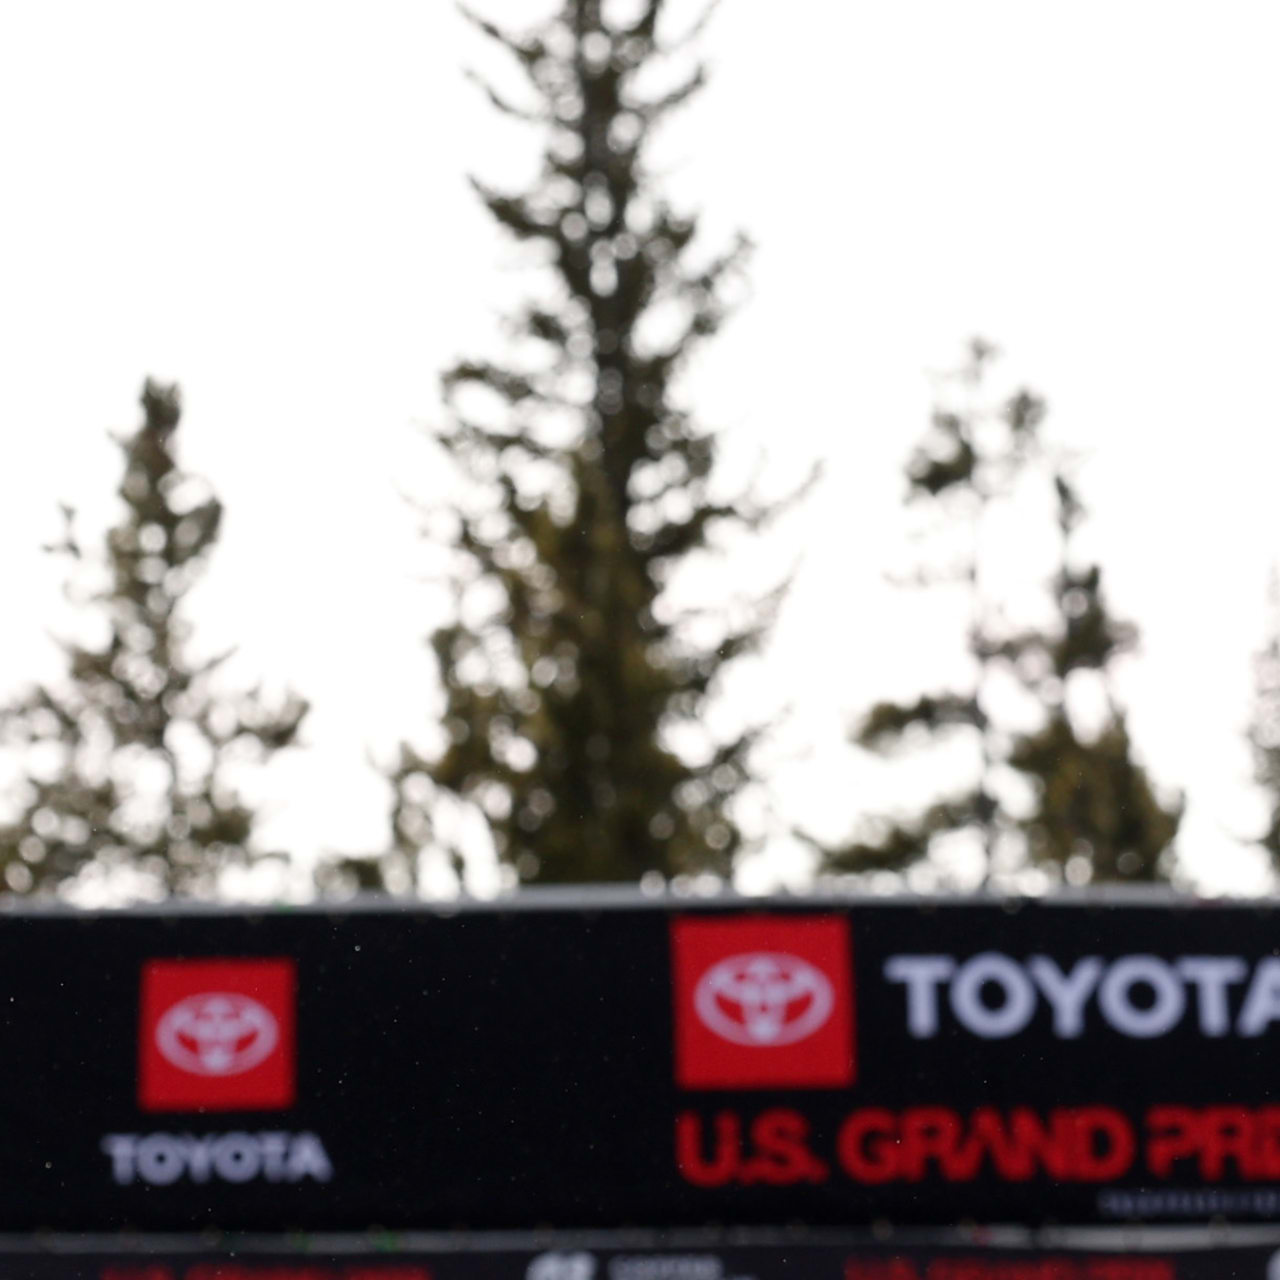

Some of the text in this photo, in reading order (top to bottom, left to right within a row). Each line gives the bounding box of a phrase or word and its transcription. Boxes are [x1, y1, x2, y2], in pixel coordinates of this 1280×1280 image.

[104, 1131, 333, 1184] TOYOTA
[675, 1107, 827, 1187] U.S.
[837, 1106, 1136, 1185] GRAND
